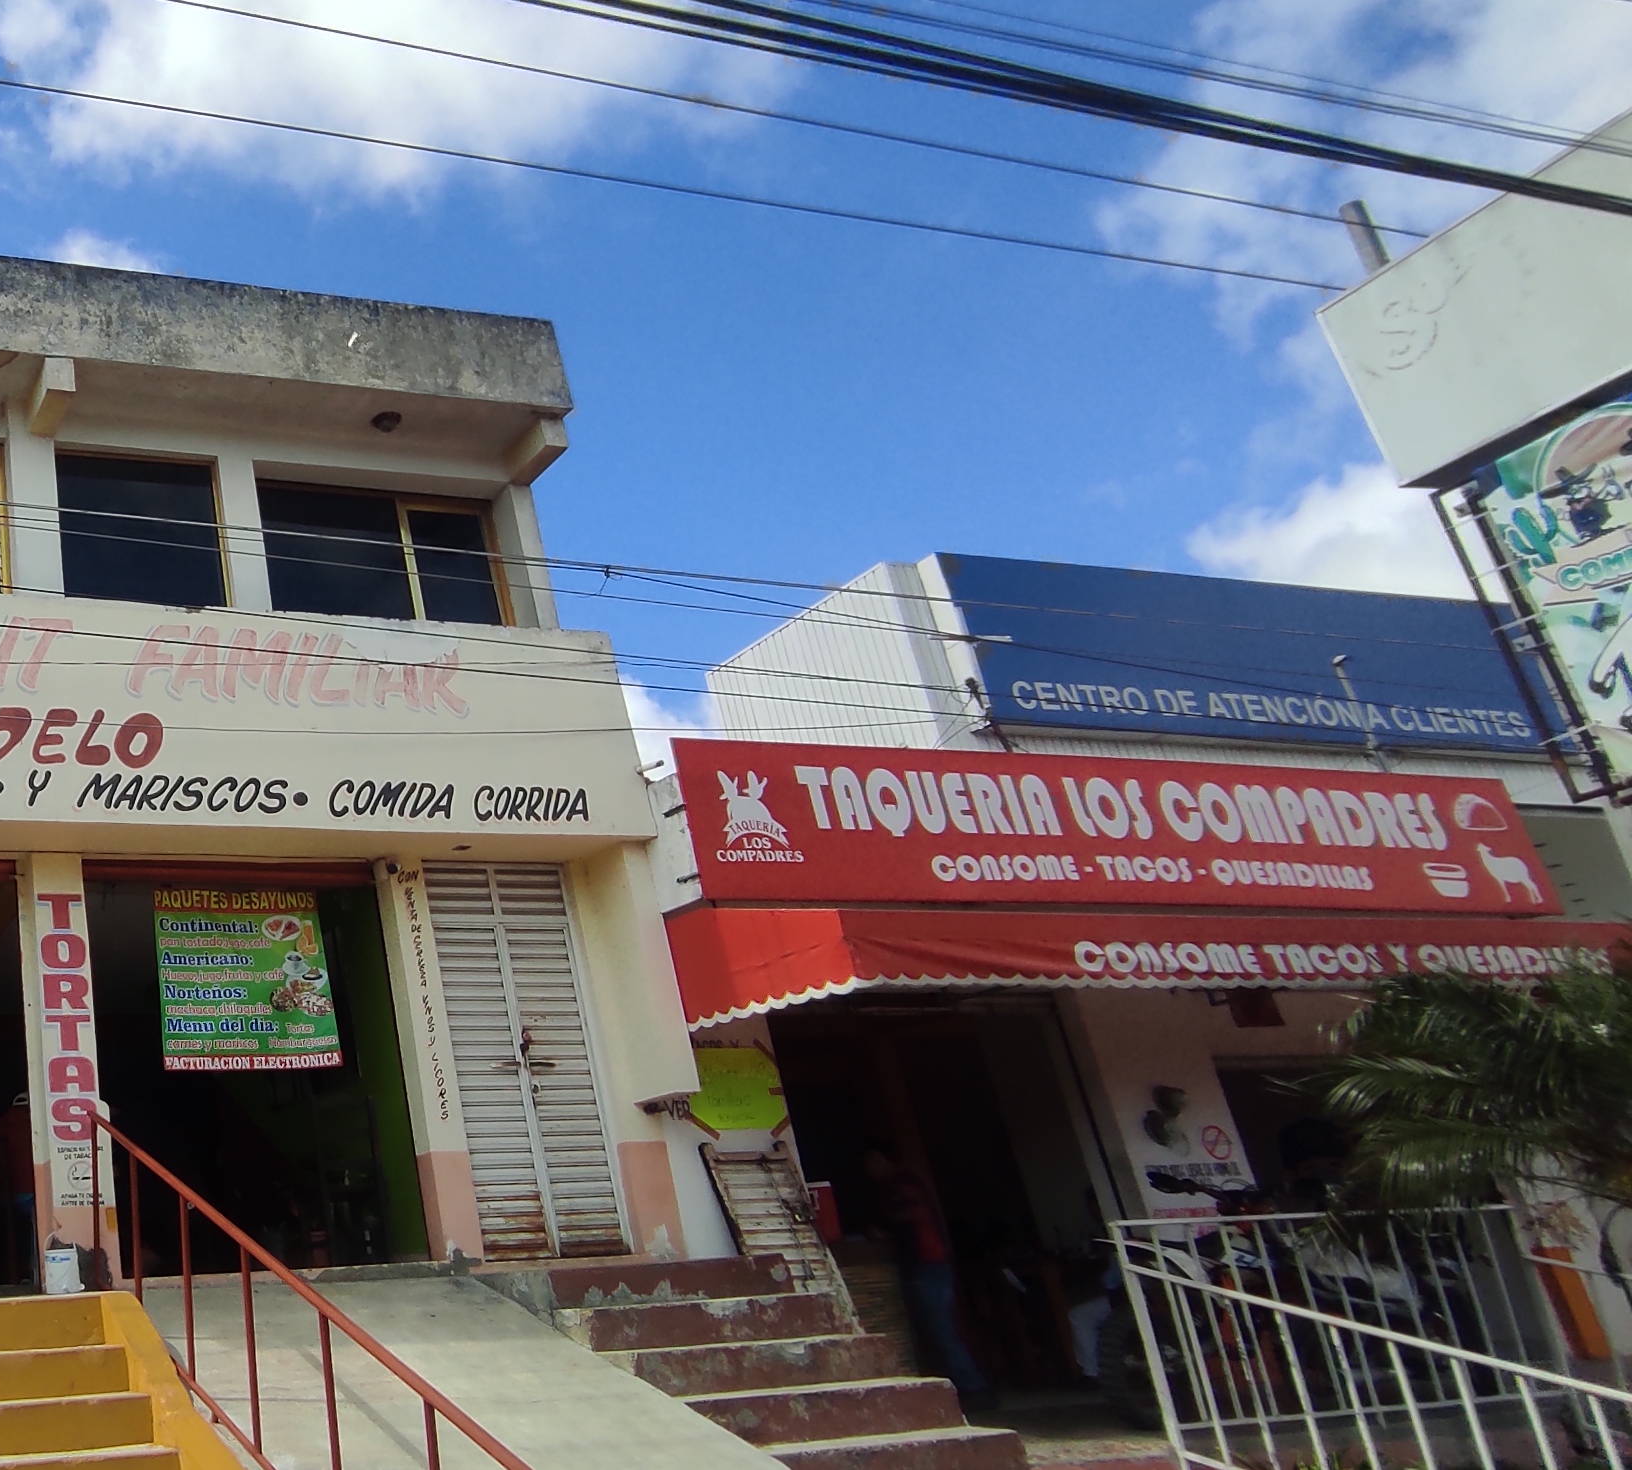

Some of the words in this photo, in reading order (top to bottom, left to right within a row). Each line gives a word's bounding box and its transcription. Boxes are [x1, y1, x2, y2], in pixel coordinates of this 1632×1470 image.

[1557, 543, 1632, 591] COM
[1011, 680, 1154, 718] CENTRO
[1156, 690, 1202, 718] DE
[1366, 705, 1395, 731] A
[1393, 706, 1532, 739] CLIENTES
[27, 769, 52, 807] Y
[77, 773, 288, 813] MARISCOS
[329, 779, 454, 820] COMIDA
[474, 785, 589, 822] CORRIDA
[794, 765, 1063, 837] TAQUERIA
[1062, 775, 1153, 840] LOS
[1160, 780, 1448, 851] COMPADRES
[743, 837, 772, 850] LOS
[716, 848, 805, 863] COMPADRES
[397, 869, 420, 884] CON
[931, 855, 1080, 882] CONSOME
[1098, 856, 1192, 883] TACOS
[1211, 858, 1374, 891] QUESADILLAS
[154, 889, 228, 909] PAQUETES
[231, 891, 315, 910] DESAYUNOS
[404, 886, 418, 922] VENTA
[158, 917, 259, 934] Continental:
[410, 924, 423, 934] DE
[159, 937, 180, 949] pan
[161, 951, 254, 966] Americano:
[413, 935, 428, 988] CERVEZA
[1074, 940, 1263, 976] CONSOME
[1264, 942, 1383, 976] TACOS
[1387, 943, 1409, 973] Y
[164, 984, 247, 1000] Norteños:
[37, 893, 98, 1142] TORTAS
[422, 994, 437, 1033] VINOS
[166, 1018, 215, 1033] Menu
[219, 1017, 244, 1033] del
[214, 1037, 258, 1050] mariscos
[164, 1054, 251, 1071] FACTURACION
[253, 1052, 341, 1070] ELECTRONICA
[432, 1052, 450, 1121] LICORES
